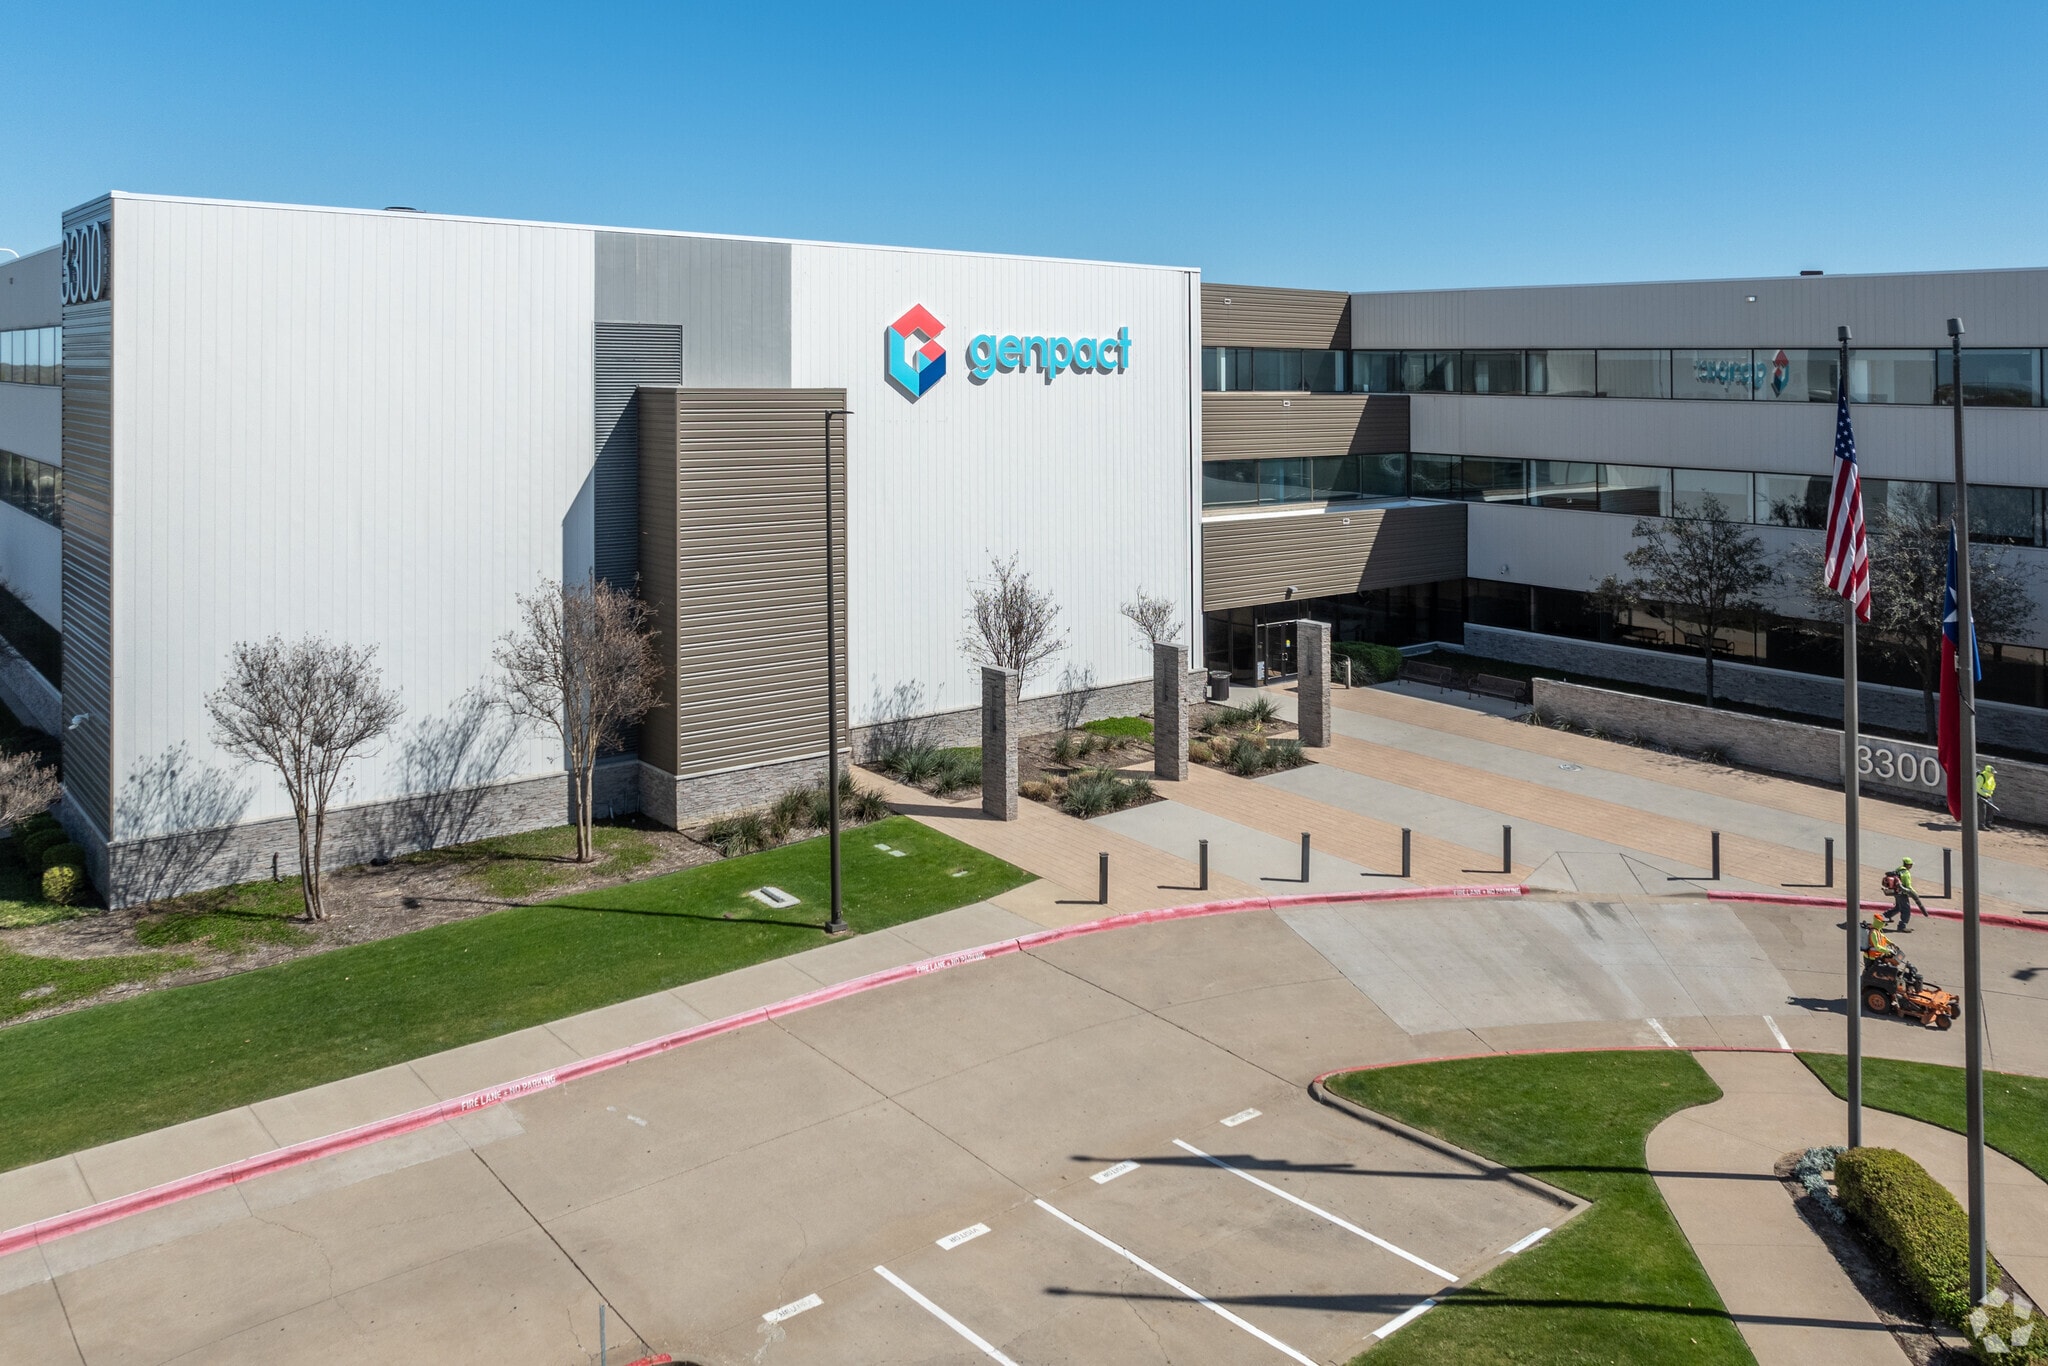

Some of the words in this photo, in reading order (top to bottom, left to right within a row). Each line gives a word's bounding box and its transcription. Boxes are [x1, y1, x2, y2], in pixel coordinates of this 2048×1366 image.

[61, 221, 101, 305] 3300
[968, 326, 1133, 381] genpact
[1857, 745, 1941, 787] 3300
[461, 1096, 480, 1112] FIRE
[480, 1090, 502, 1106] LANE
[509, 1084, 522, 1095] NO
[523, 1074, 556, 1091] PARKING
